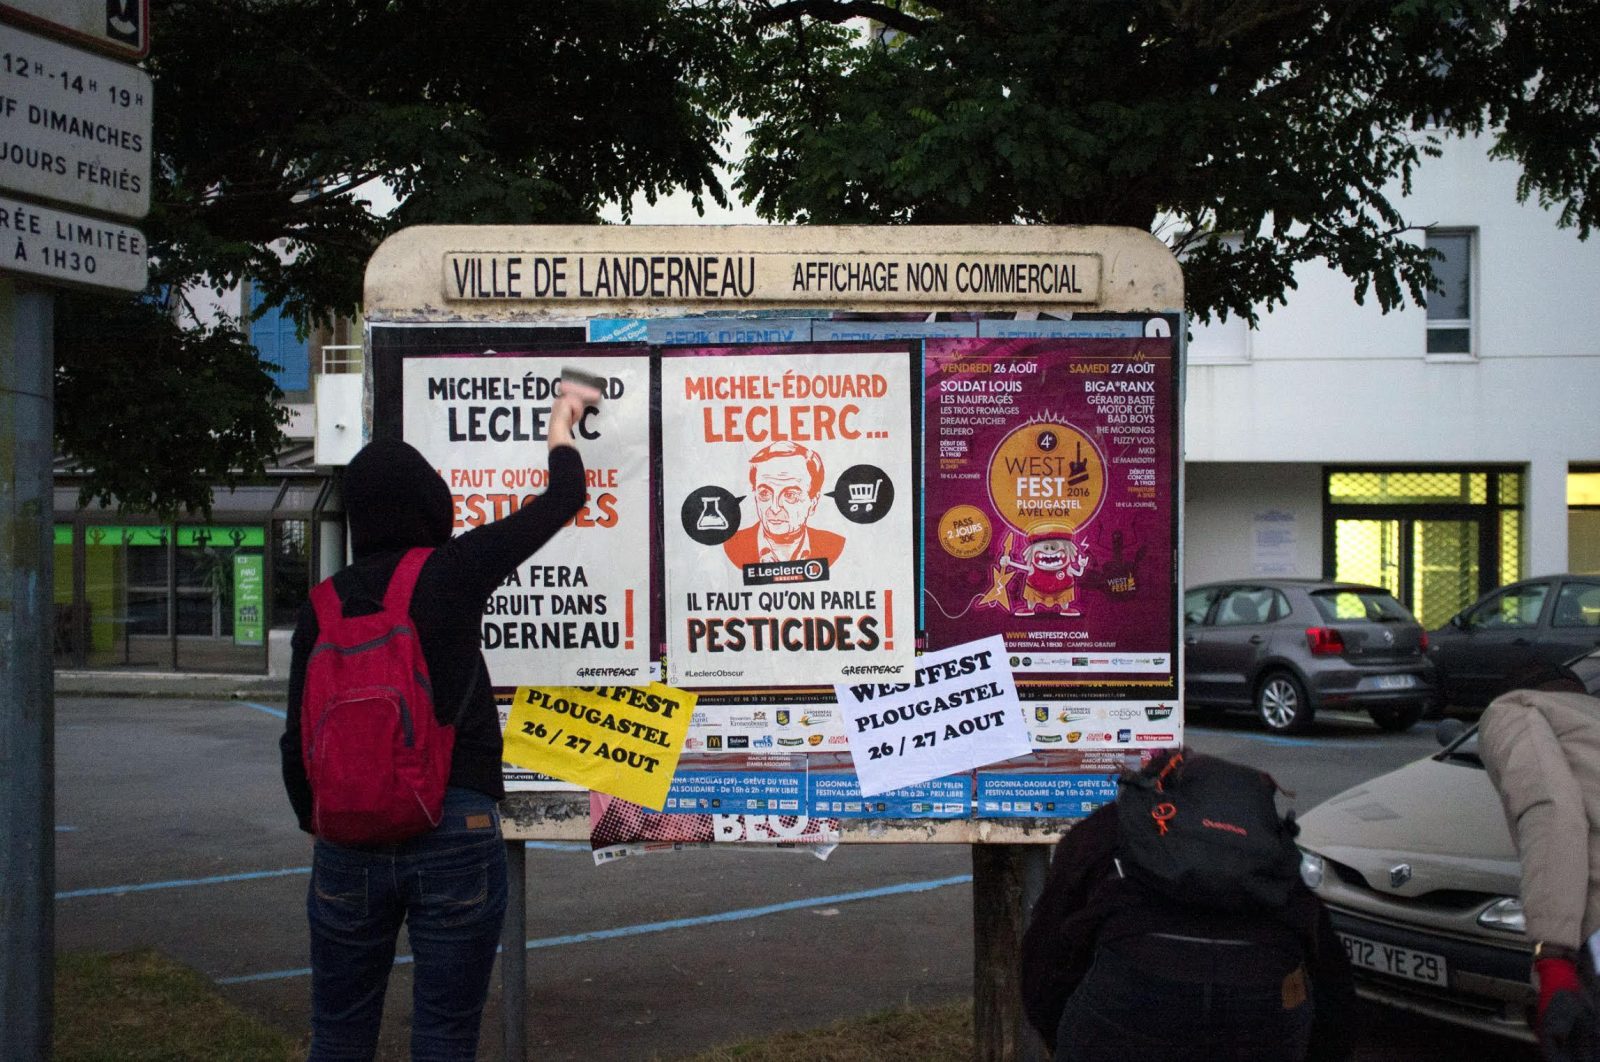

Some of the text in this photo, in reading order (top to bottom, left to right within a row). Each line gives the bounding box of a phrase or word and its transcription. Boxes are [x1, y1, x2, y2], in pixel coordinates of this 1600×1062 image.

[29, 104, 143, 152] DIMANCHES
[56, 220, 140, 255] LIMITÉE
[15, 237, 96, 273] À 1H30
[453, 256, 1081, 298] VILLE DE LANDERNEAU AFFICHAGE NON COMMERCIAL
[942, 361, 1038, 373] VENDREDI 26 AOÛT
[1069, 361, 1155, 374] SAMEDI 27 AOÛT
[685, 369, 888, 401] MICHEL-ÉDOUARD
[940, 380, 1022, 392] SOLDAT LOUIS
[940, 393, 1013, 405] LES NAUFRAGÉS
[1087, 393, 1155, 405] GÉRARD BASTE
[976, 406, 1019, 415] FROMAGES
[1096, 405, 1155, 414] MOTOR CITY
[1107, 414, 1155, 424] BAD BOYS
[448, 406, 602, 442] LECLEC
[703, 404, 889, 443] LECLERC...
[940, 417, 1006, 425] DREAM CATCHER
[1096, 426, 1108, 434] THE
[1005, 456, 1065, 476] WEST
[451, 469, 497, 488] FAUT
[1016, 477, 1090, 497] FEST 2016
[1017, 500, 1081, 509] PLOUGASTEL
[1018, 507, 1070, 517] AVEL VOR
[953, 517, 973, 528] PASS
[530, 565, 589, 588] FERA
[483, 594, 607, 616] BRUIT DANS
[687, 590, 876, 612] IL FAUT QU'ON PARLE
[686, 615, 879, 652] PESTICIDES
[576, 667, 639, 677] GREENPEACE
[685, 669, 744, 678] #LeclercObscur
[841, 664, 904, 676] GREENPEACE
[855, 682, 1004, 733] PLOUGASTEL
[526, 689, 671, 748] PLOUGASTEL
[867, 743, 894, 760] 26
[912, 731, 936, 748] 27
[943, 710, 1005, 741] AOUT
[521, 721, 547, 738] 26
[564, 735, 591, 754] 27
[594, 743, 660, 773] AOUT
[816, 789, 845, 797] FESTIVAL
[985, 780, 1057, 788] LOGONNA-DAOULAS
[1383, 946, 1408, 975] YE
[1412, 954, 1440, 981] 29
